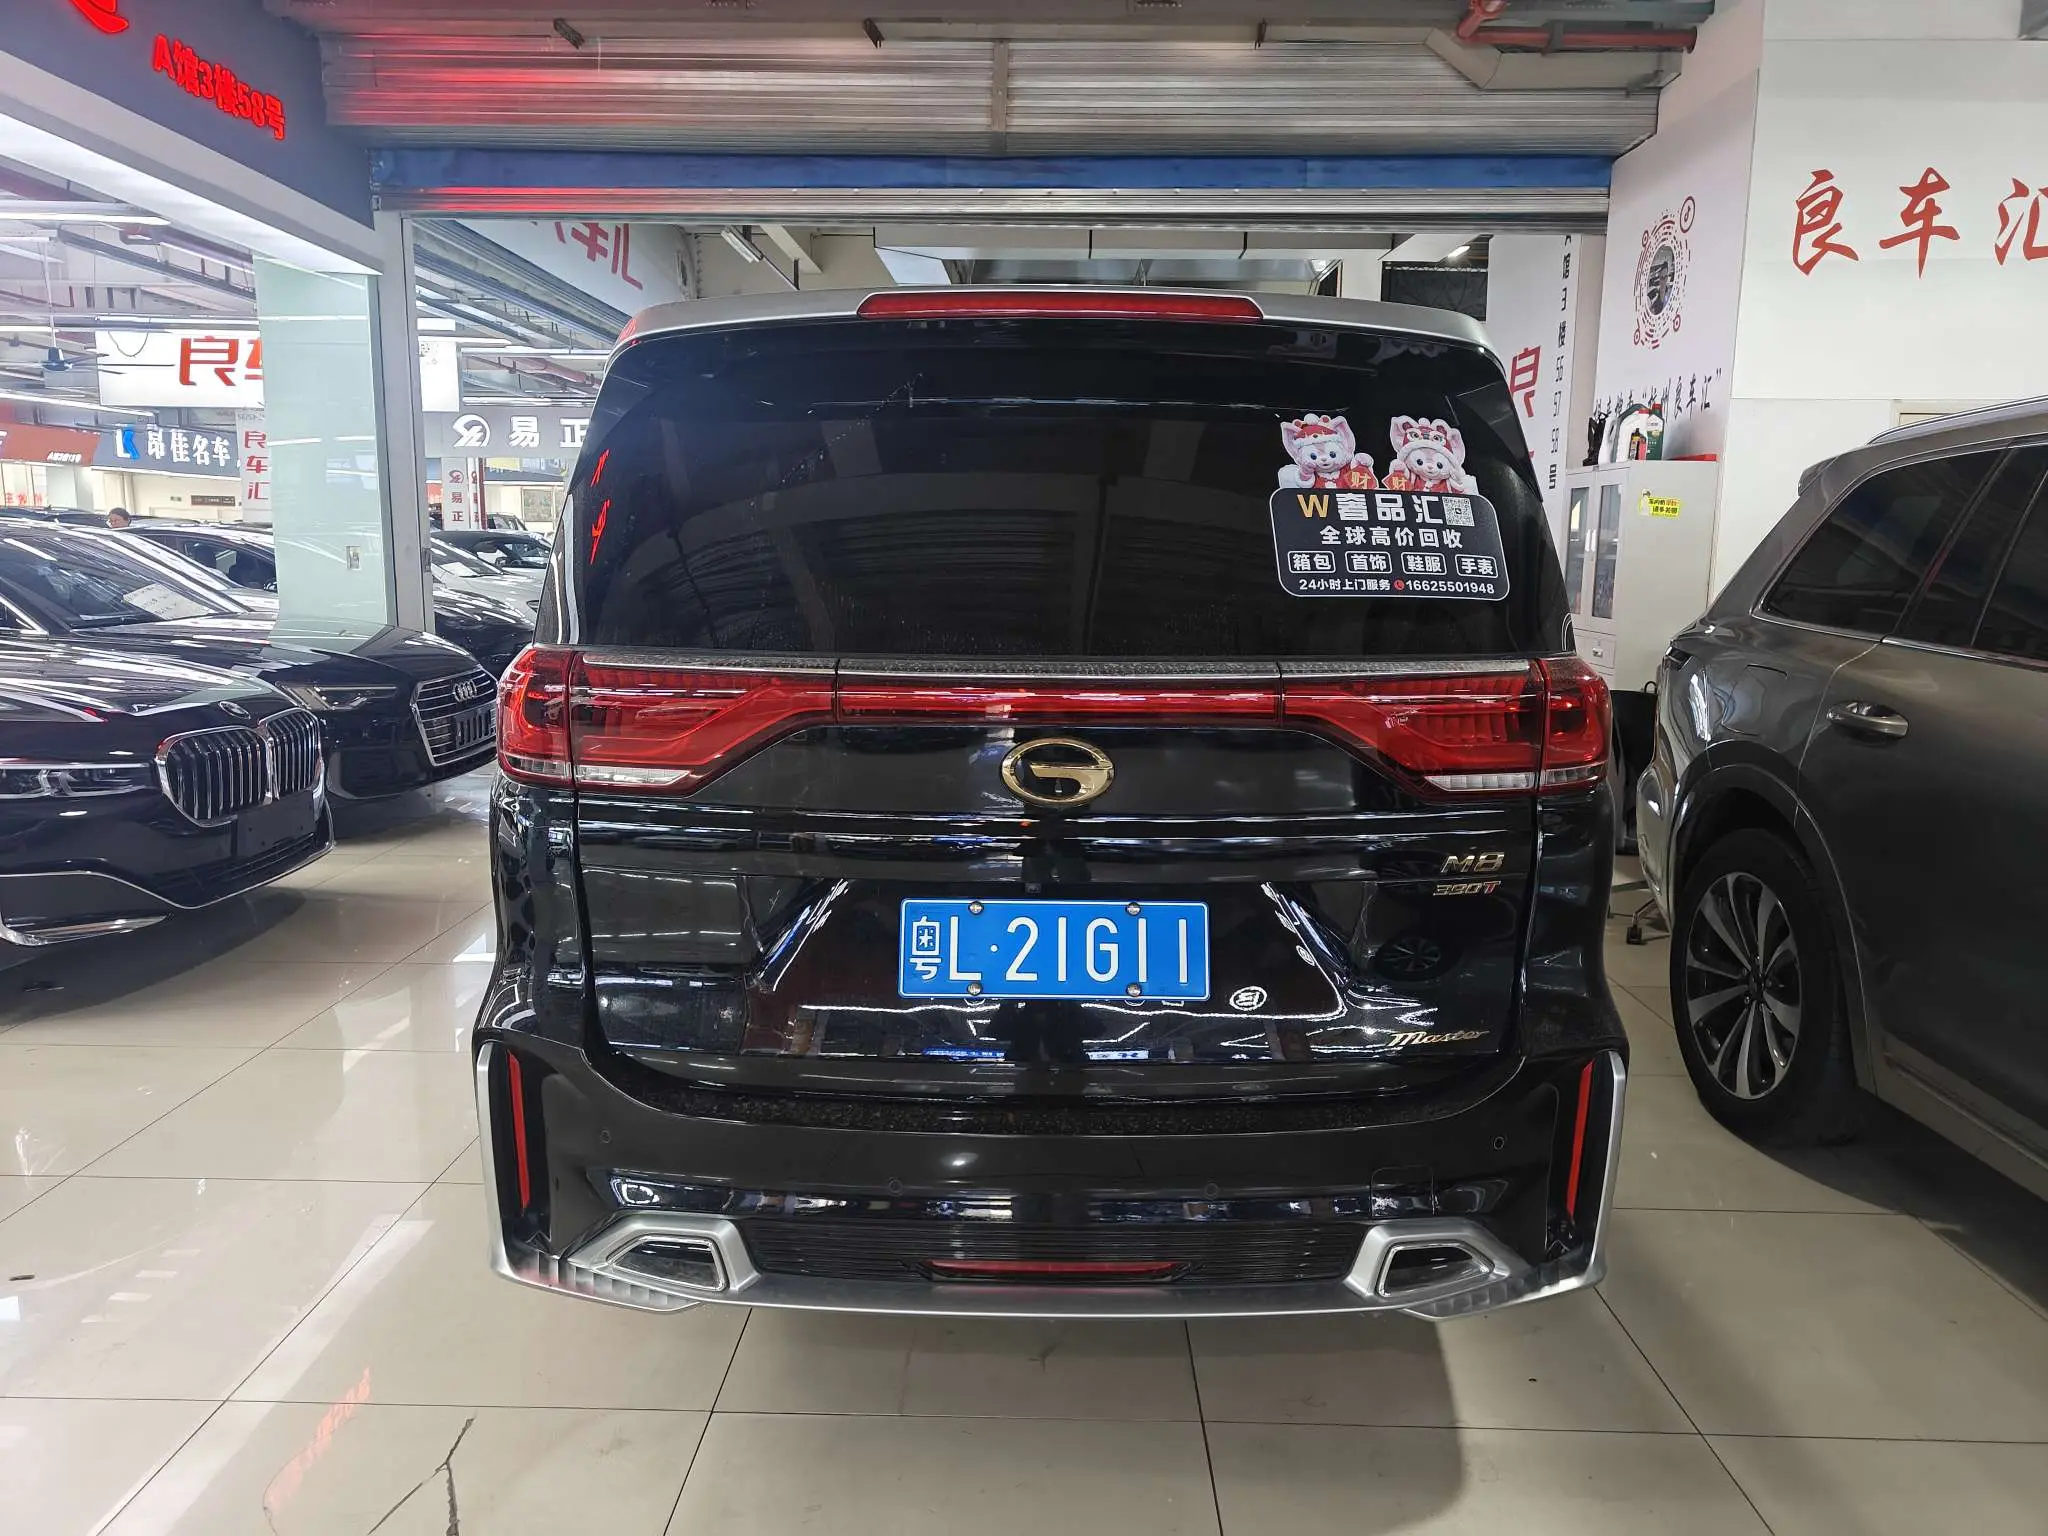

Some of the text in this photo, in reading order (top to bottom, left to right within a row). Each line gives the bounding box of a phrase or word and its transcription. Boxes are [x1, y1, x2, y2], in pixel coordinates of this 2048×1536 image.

[153, 33, 285, 140] A馆3楼58号
[1792, 167, 2048, 278] 良车汇
[531, 221, 643, 290] 车汇
[243, 430, 270, 500] 良车汇
[1320, 525, 1463, 549] 全球高价回收
[1293, 553, 1494, 575] 箱包 首饰 鞋服 手表
[1299, 578, 1495, 594] 24小时上门服务 16625501948
[1441, 852, 1505, 872] M8
[1386, 1030, 1491, 1047] Master
